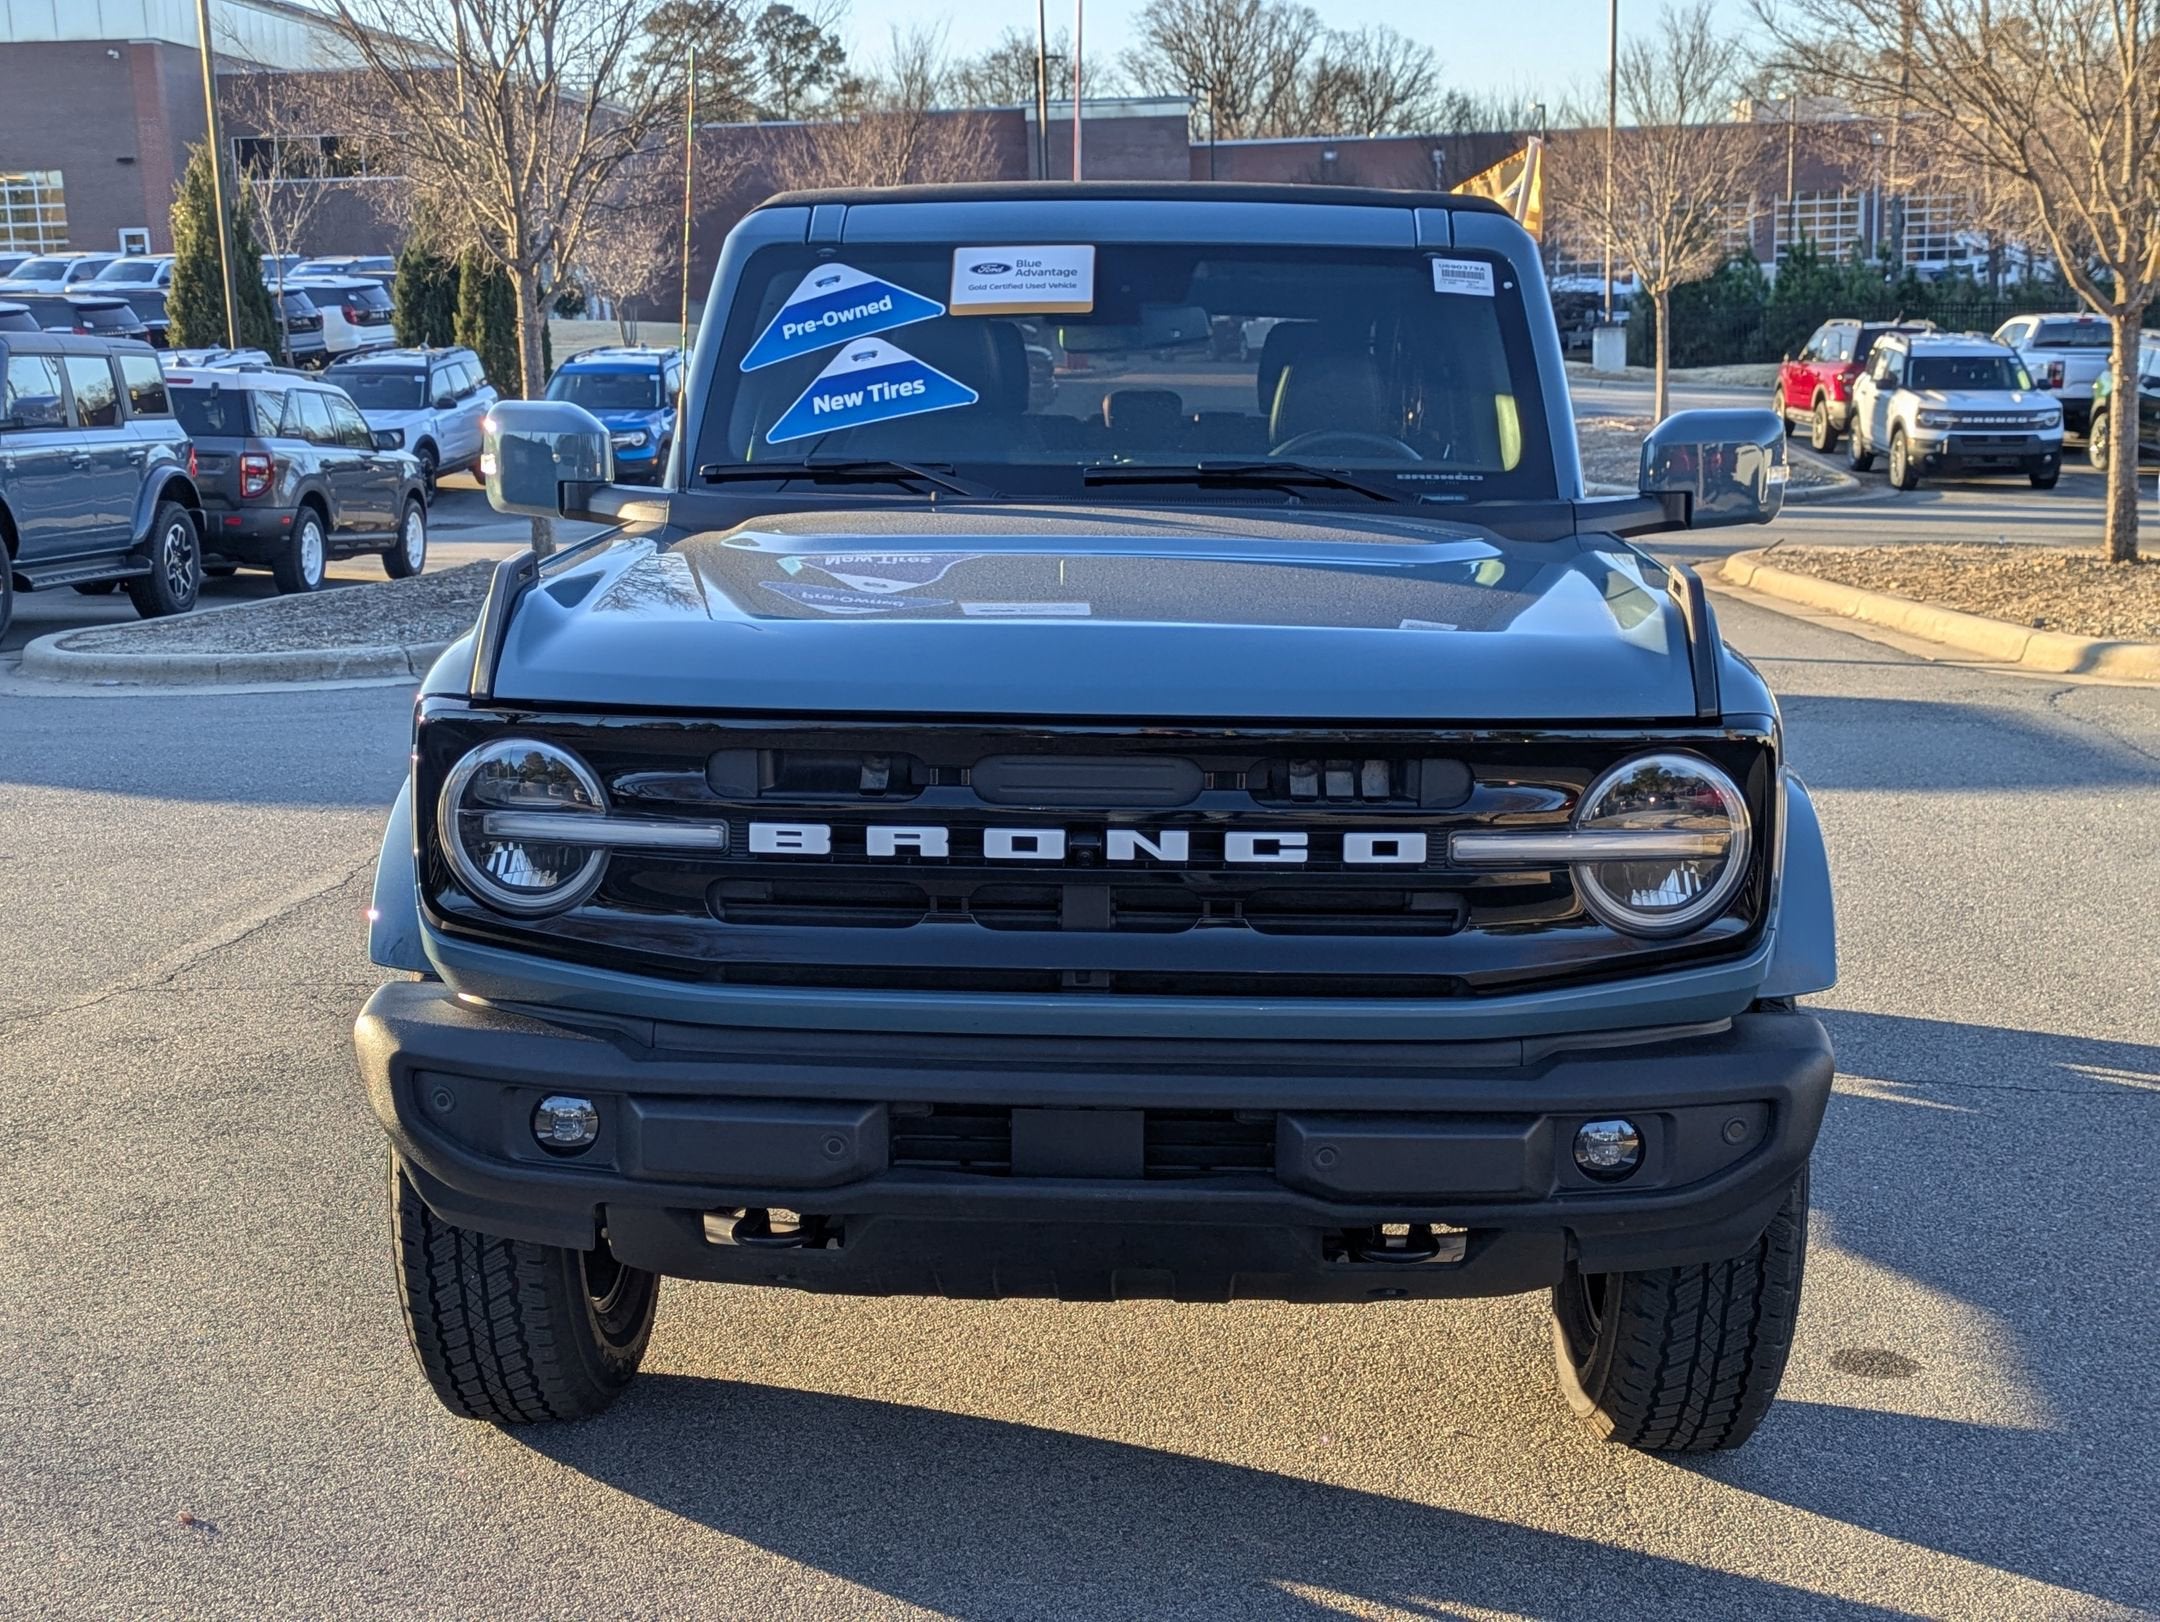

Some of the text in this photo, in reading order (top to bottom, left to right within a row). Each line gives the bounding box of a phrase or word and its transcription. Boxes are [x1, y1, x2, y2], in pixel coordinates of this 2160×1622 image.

[1015, 268, 1078, 278] Advantage
[1016, 259, 1042, 268] Blue
[968, 283, 988, 291] Gold
[782, 295, 893, 340] Pre-Owned
[812, 378, 926, 416] New Tires
[748, 821, 1427, 864] BRONCO
